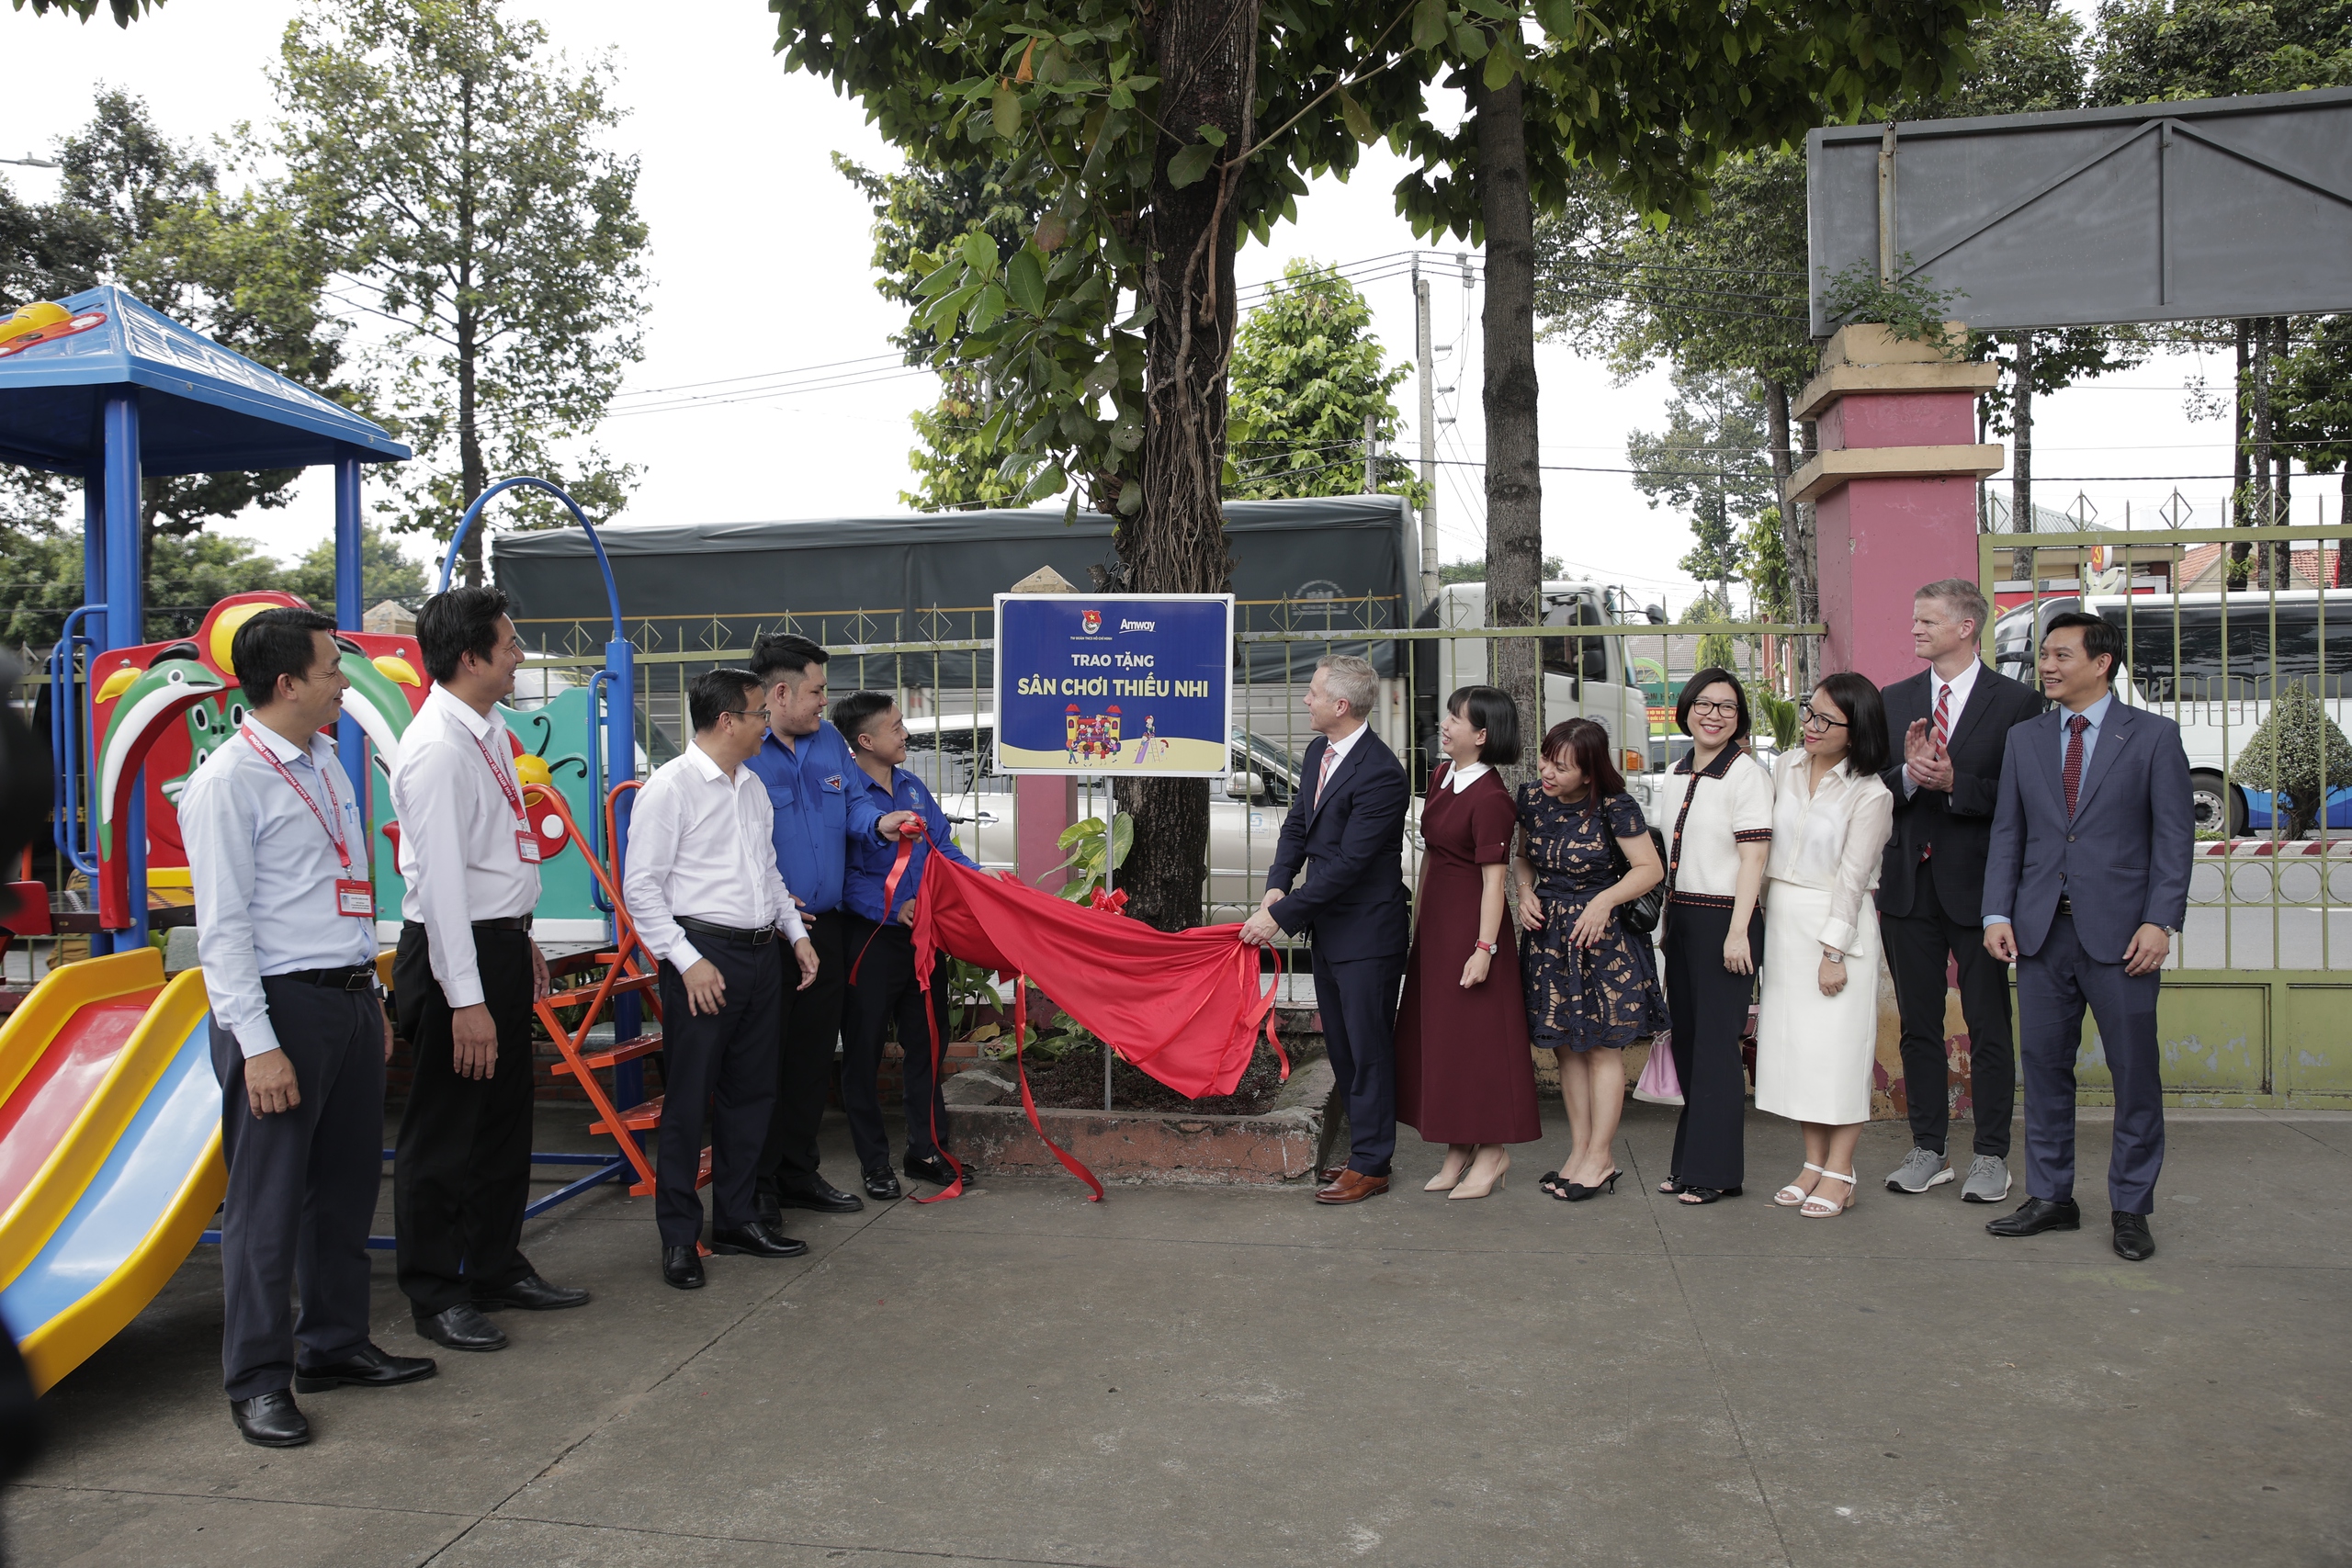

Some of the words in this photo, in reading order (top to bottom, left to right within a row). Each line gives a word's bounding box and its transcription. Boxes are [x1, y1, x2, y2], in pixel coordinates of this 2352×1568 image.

[1120, 618, 1156, 633] Amway
[1071, 654, 1112, 667] TRAO
[1114, 651, 1155, 671] TẶNG
[1017, 673, 1057, 695] SÂN
[1061, 676, 1108, 696] CHƠI
[1113, 671, 1170, 697] THIẾU
[1174, 681, 1209, 698] NHI
[248, 734, 266, 752] DƯƠNG
[263, 750, 278, 764] BÌNH
[483, 750, 493, 763] NAM
[491, 762, 500, 774] VIỆT
[497, 773, 508, 787] MTTQ
[295, 784, 310, 799] NAM
